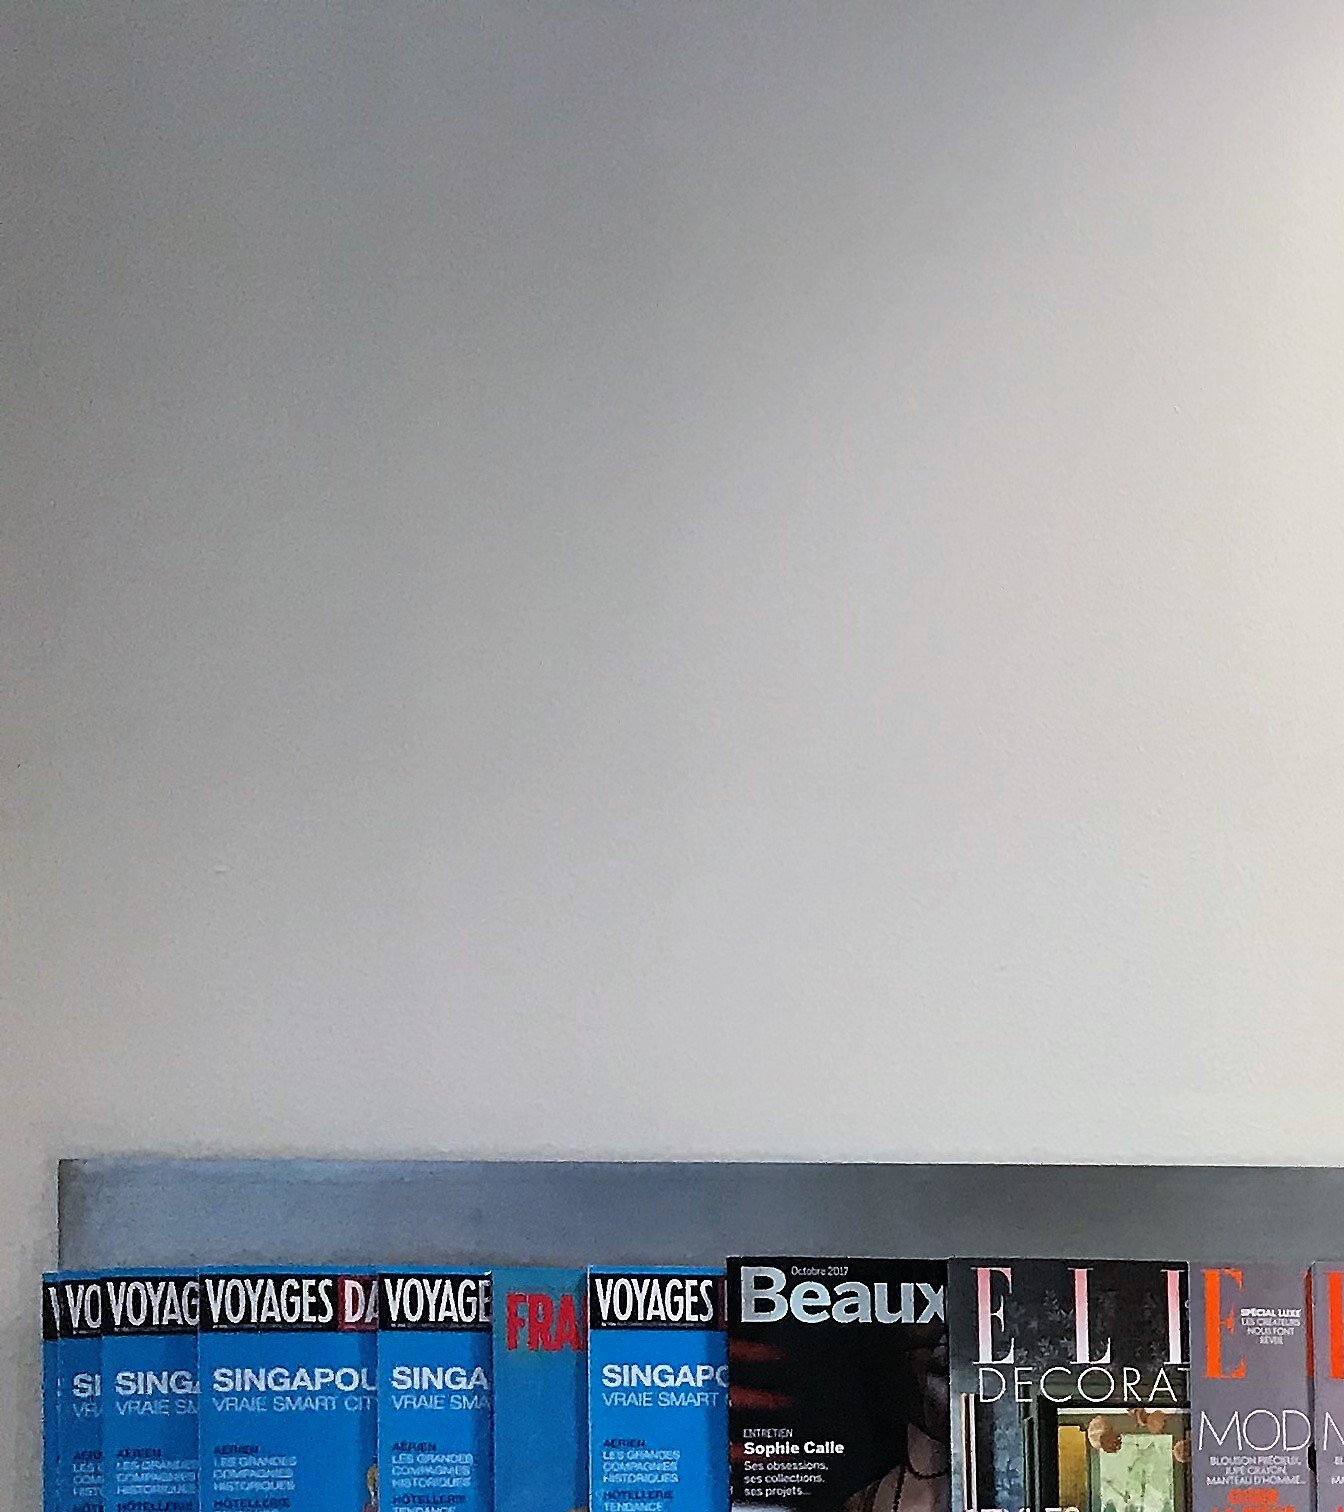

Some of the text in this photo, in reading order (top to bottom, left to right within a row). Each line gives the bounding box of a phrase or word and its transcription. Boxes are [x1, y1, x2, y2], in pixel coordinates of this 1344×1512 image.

[828, 1266, 849, 1275] 2017
[205, 1279, 333, 1326] VOYAGES
[595, 1278, 713, 1324] VOYAGES
[740, 1266, 945, 1324] Beaux
[212, 1396, 338, 1411] VRAIE SMART
[602, 1391, 719, 1407] VRAIE SMART
[743, 1441, 844, 1456] Sophie Calle
